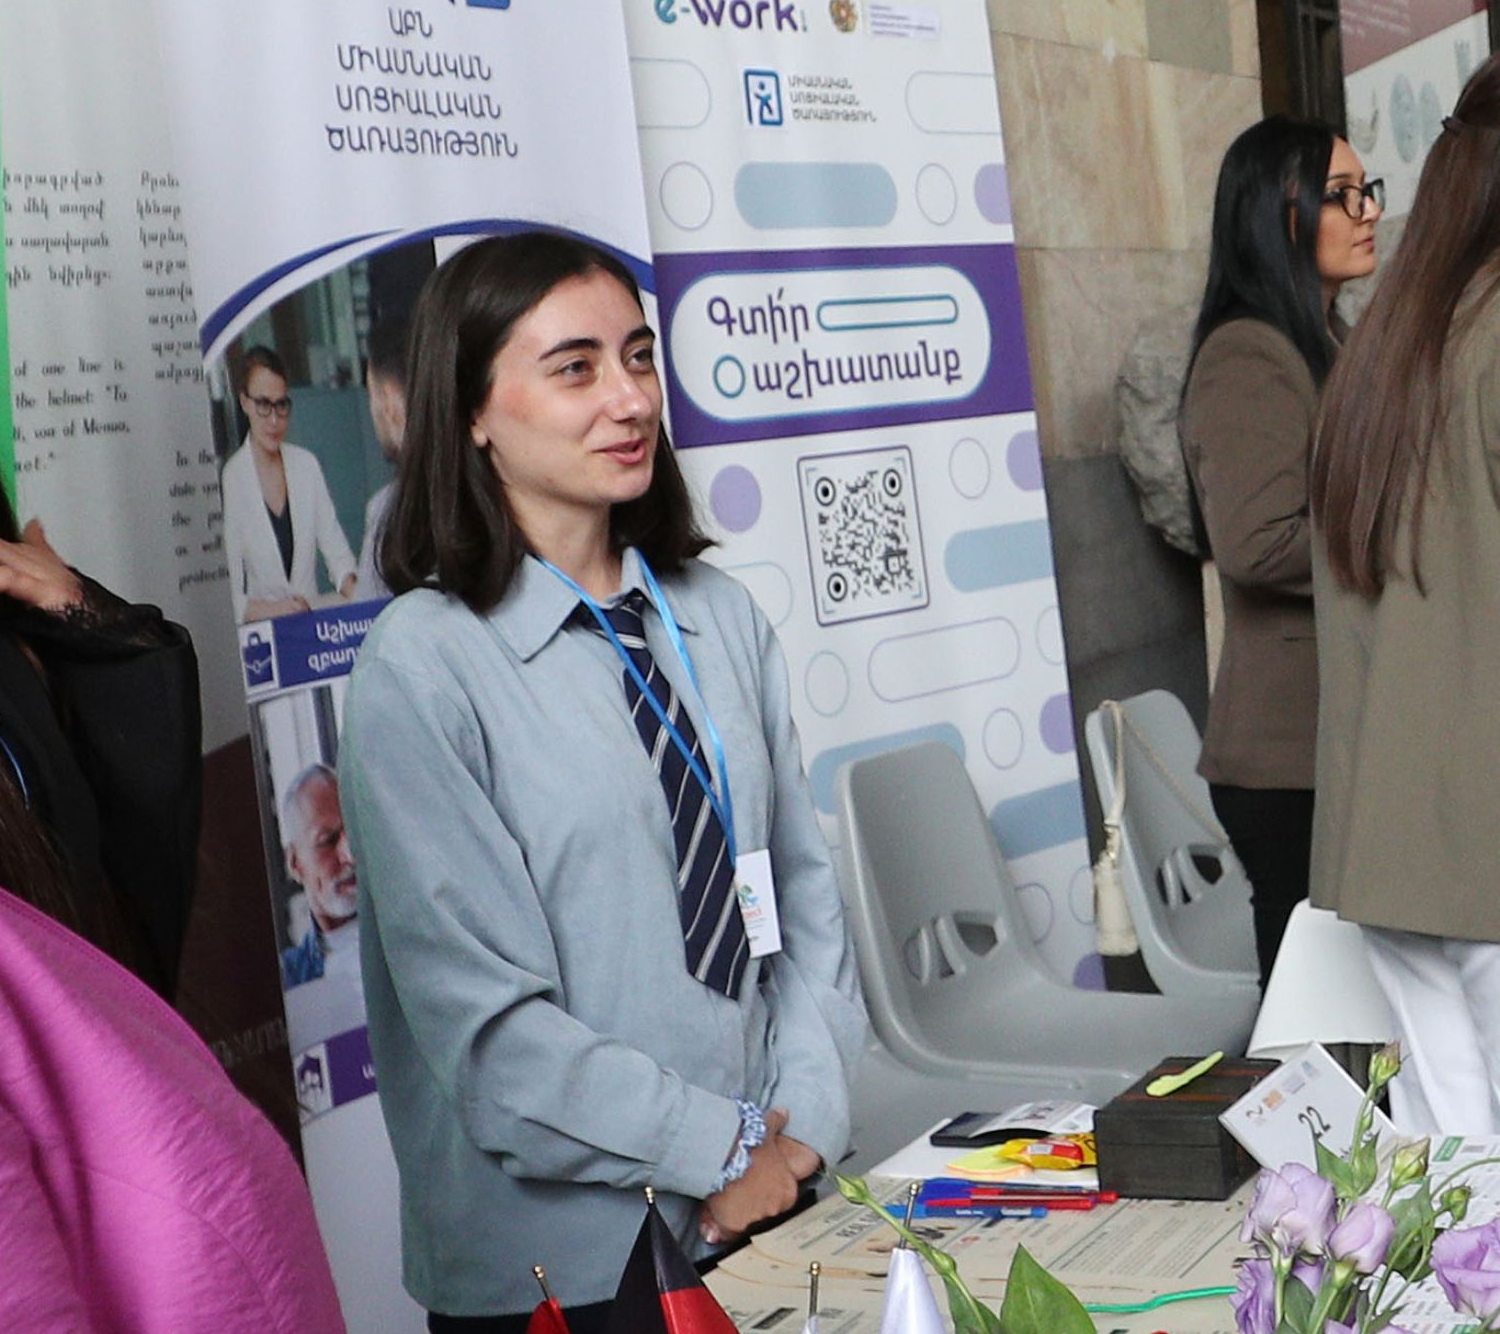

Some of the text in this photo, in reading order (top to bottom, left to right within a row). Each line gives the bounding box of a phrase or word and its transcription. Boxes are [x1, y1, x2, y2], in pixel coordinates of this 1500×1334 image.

[337, 44, 492, 81] ՄԻԱՍՆԱԿԱՆ
[336, 84, 502, 119] ՍՈՑԻԱԼԱԿԱՆ
[325, 124, 518, 157] ԾԱՌԱՅՈՒԹՅՈՒՆ
[14, 361, 27, 377] of
[41, 363, 65, 376] one
[78, 357, 101, 373] line
[752, 340, 963, 399] աշխատանք
[16, 393, 35, 409] the
[315, 618, 374, 645] Աշխա
